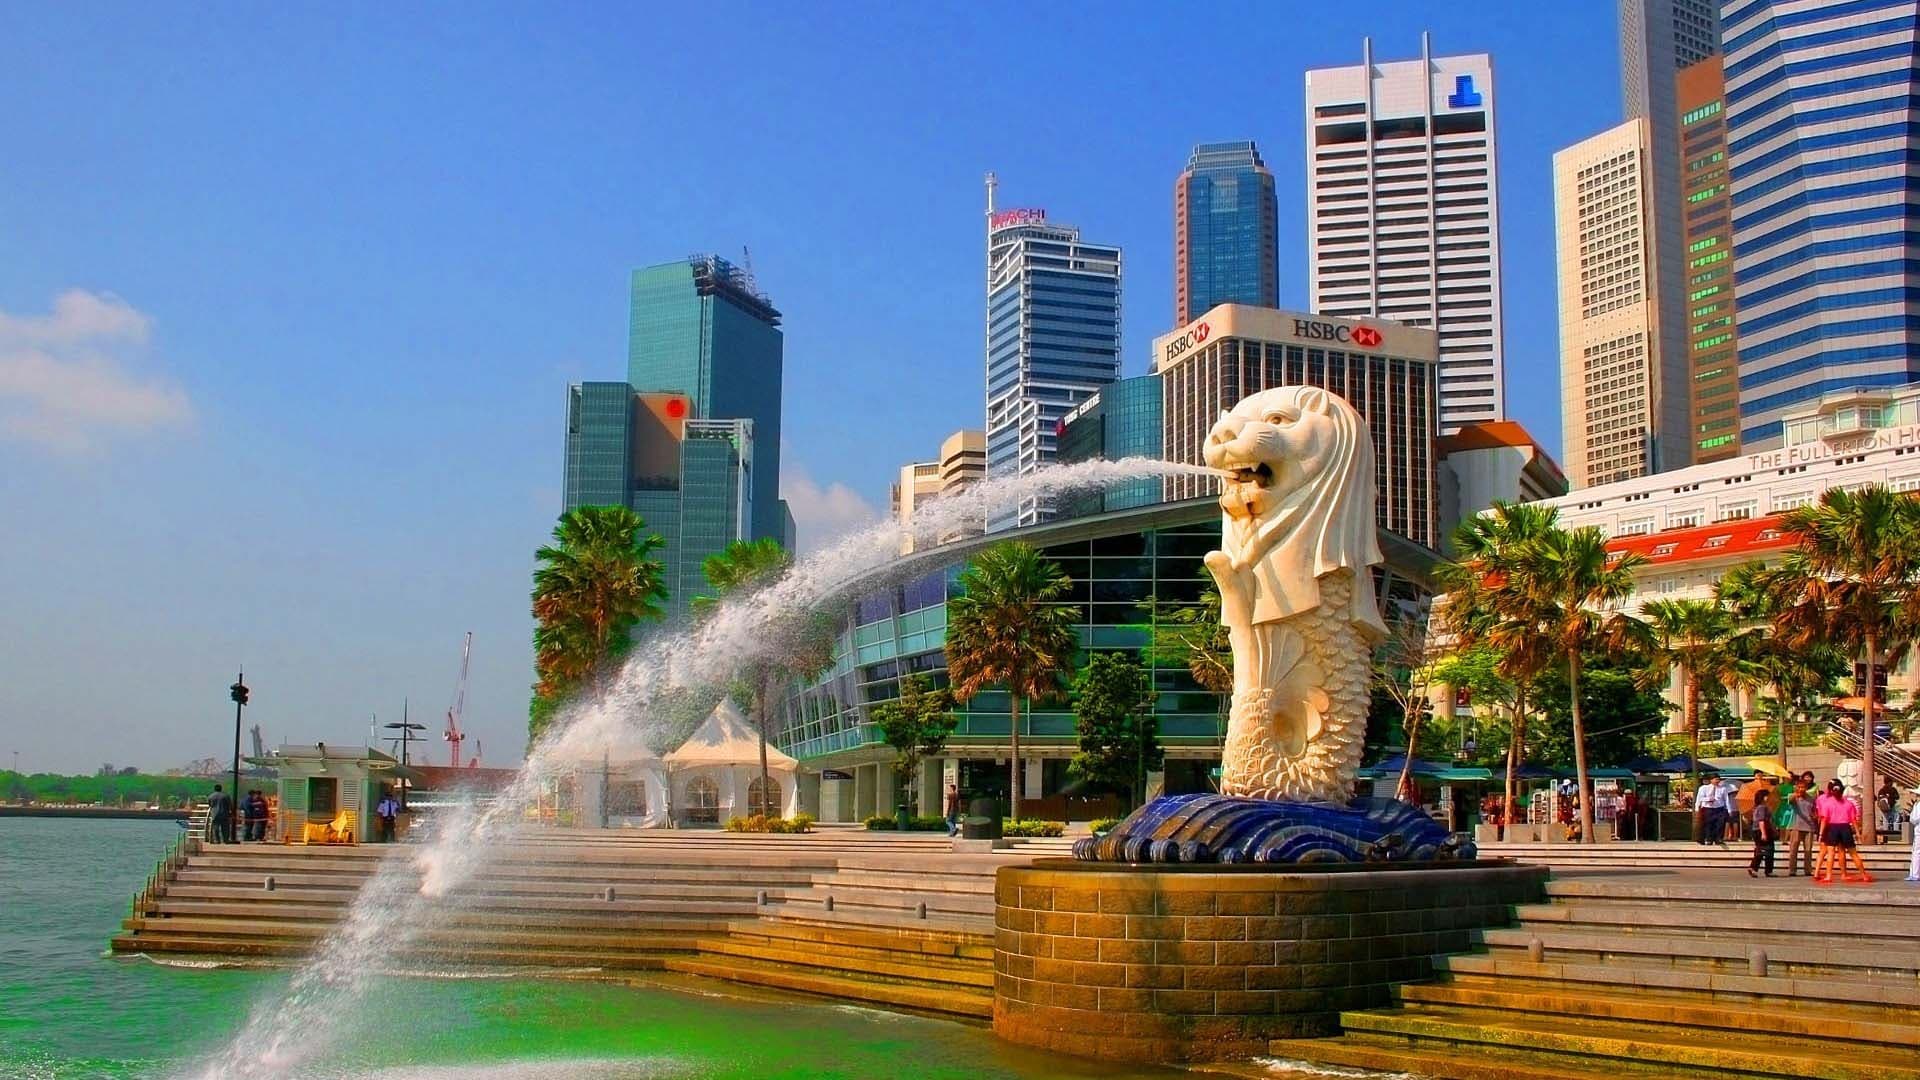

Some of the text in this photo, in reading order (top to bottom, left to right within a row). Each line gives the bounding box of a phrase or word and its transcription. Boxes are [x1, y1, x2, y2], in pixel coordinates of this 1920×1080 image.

[1166, 330, 1194, 362] HSBC
[1293, 319, 1350, 343] HSBC
[1749, 453, 1782, 470] THE
[1788, 433, 1892, 464] FULLERTON
